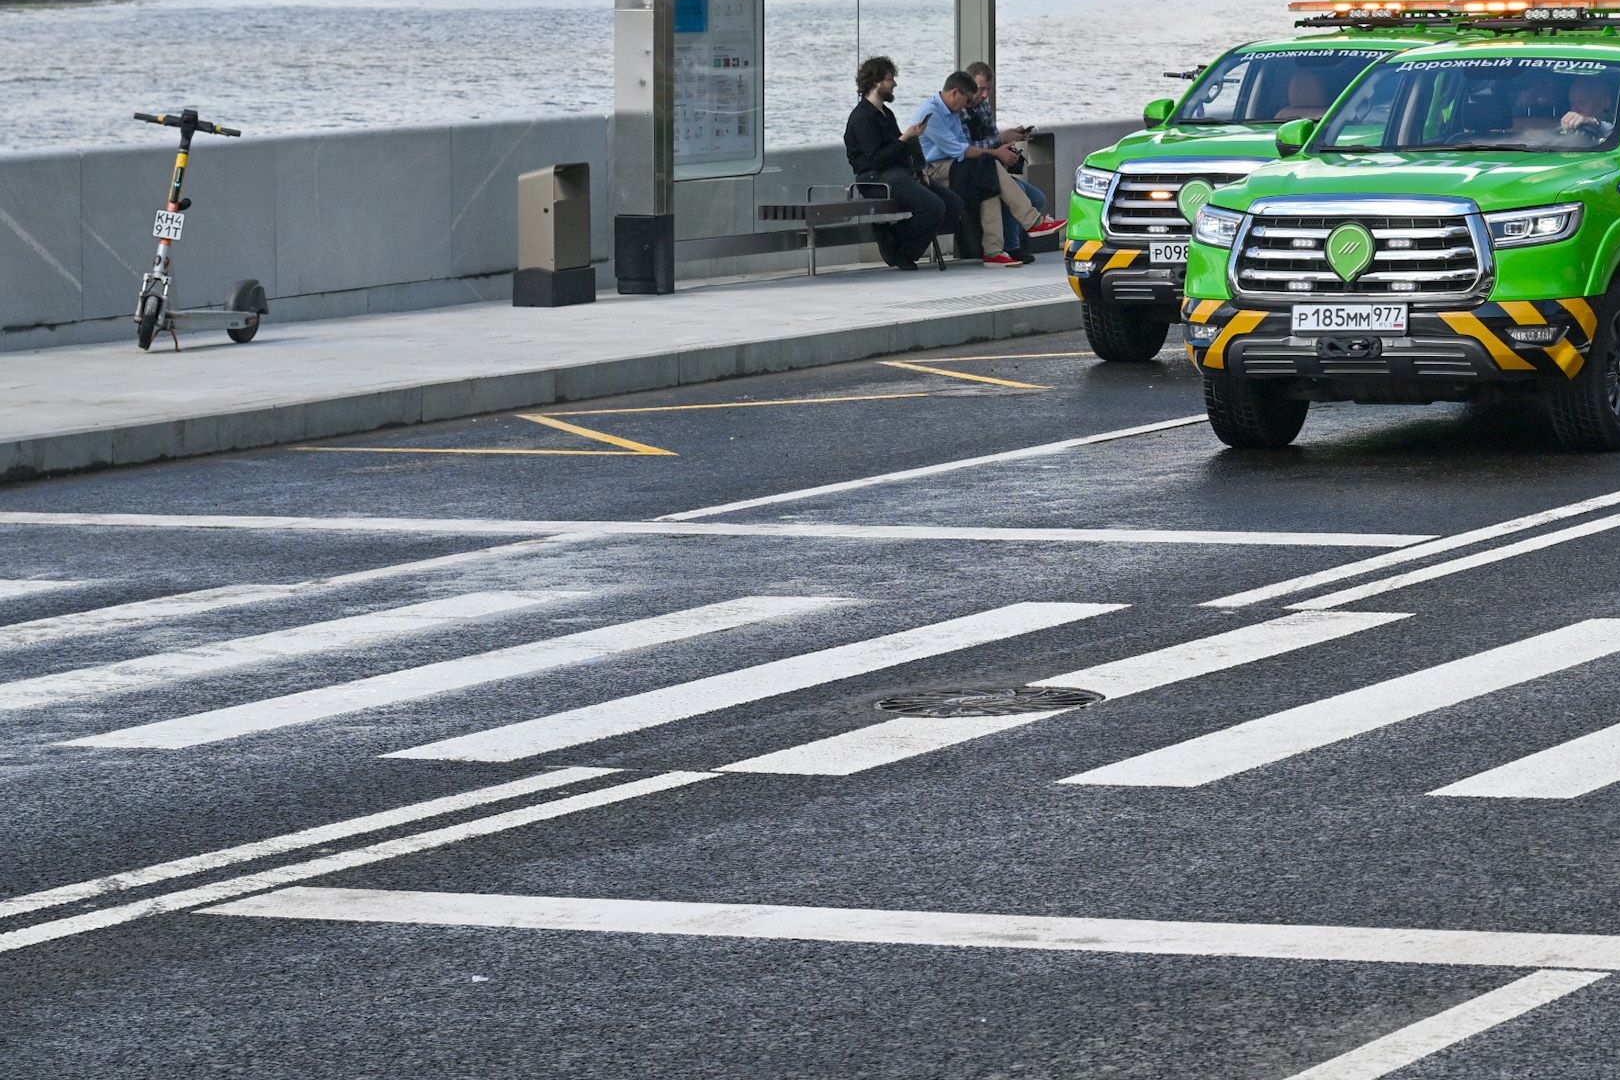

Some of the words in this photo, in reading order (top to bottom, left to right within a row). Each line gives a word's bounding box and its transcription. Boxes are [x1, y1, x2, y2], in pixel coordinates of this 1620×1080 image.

[1241, 48, 1334, 61] Дорожный
[1338, 49, 1390, 61] патру
[1395, 57, 1514, 72] Дорожный
[1518, 58, 1607, 70] патруль
[1154, 245, 1190, 260] Р098
[1298, 308, 1370, 327] Р185ММ
[1373, 307, 1402, 322] 977
